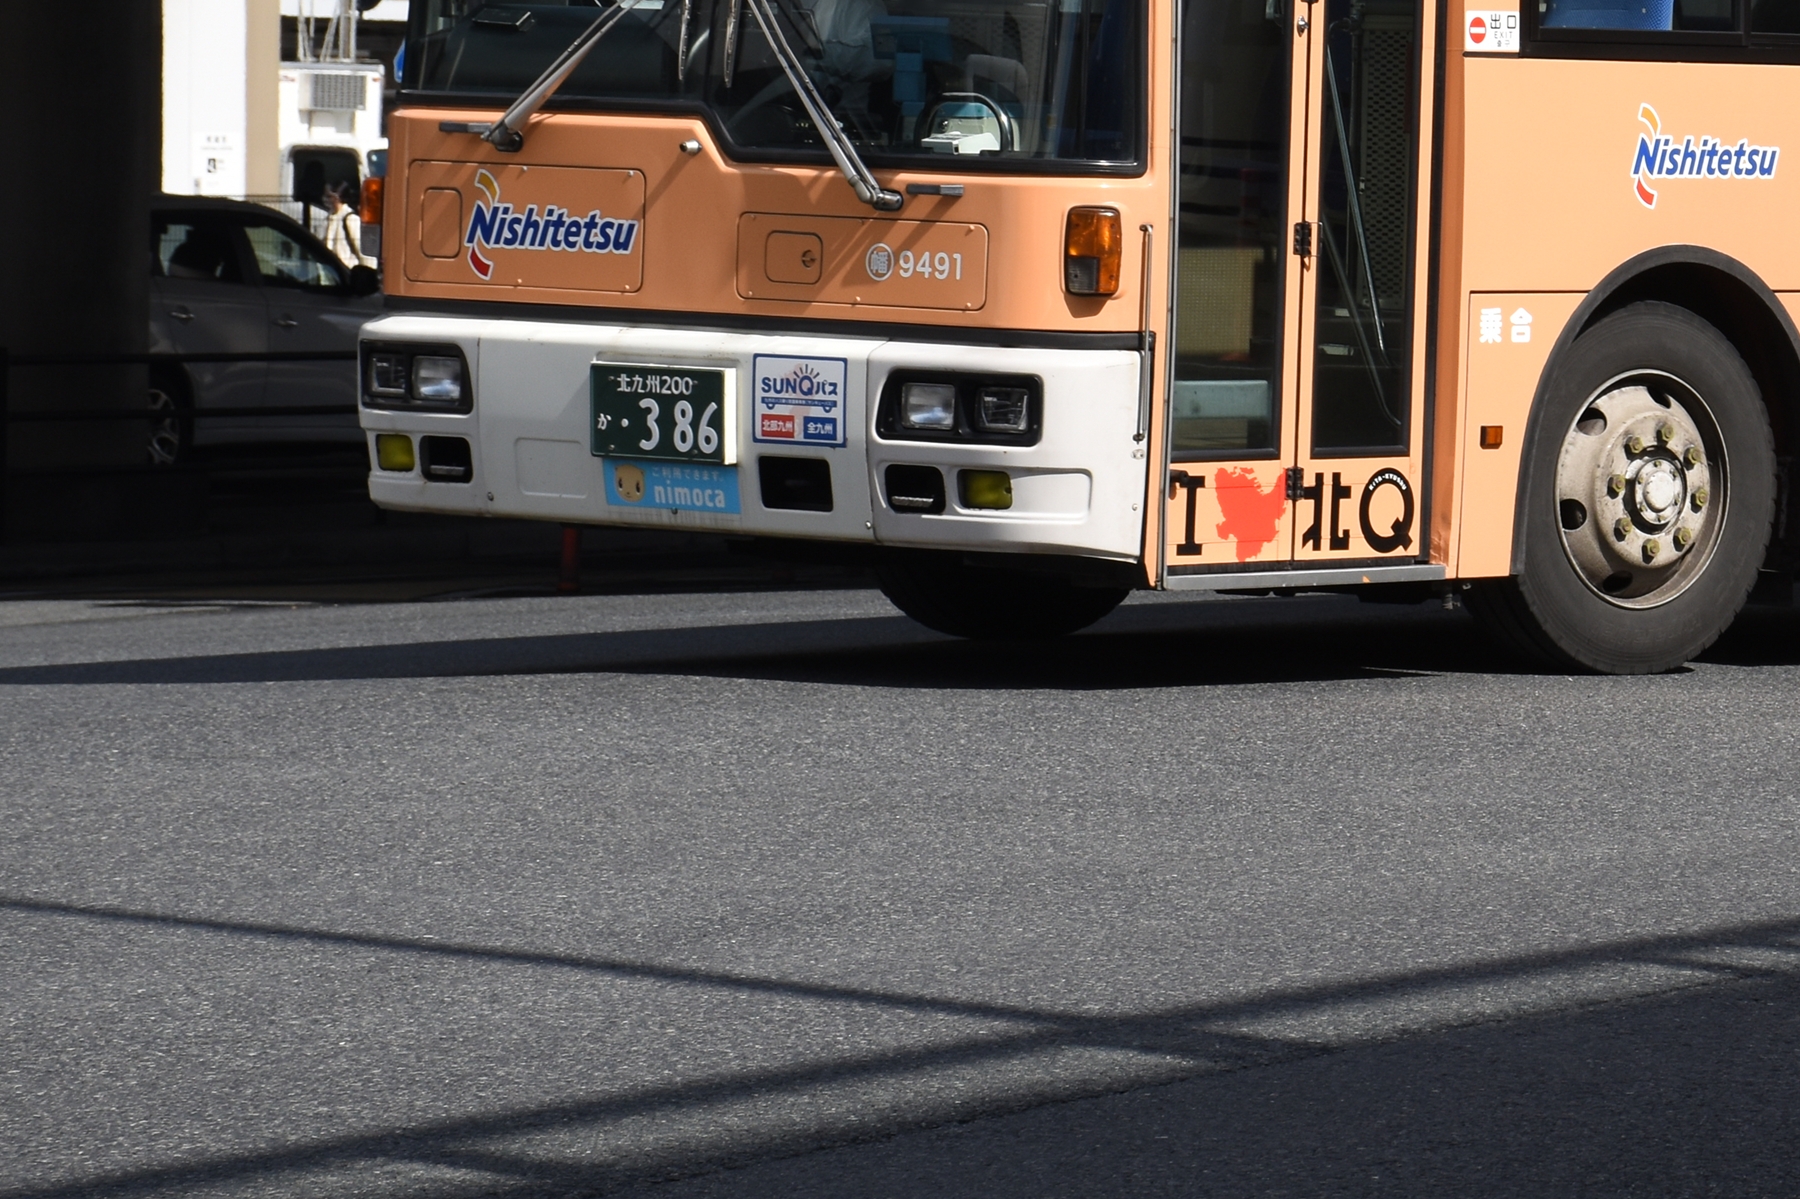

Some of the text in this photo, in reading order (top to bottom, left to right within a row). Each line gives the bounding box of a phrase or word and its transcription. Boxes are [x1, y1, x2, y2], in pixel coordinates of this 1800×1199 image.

[1490, 13, 1517, 29] 出口
[1494, 31, 1513, 39] EXIT
[1631, 132, 1780, 179] Nishitetsu
[464, 201, 638, 254] Nishitetsu
[899, 250, 962, 280] 9491
[1479, 307, 1533, 344] 乗合
[807, 422, 833, 435] 全九州
[654, 479, 726, 508] nimoca
